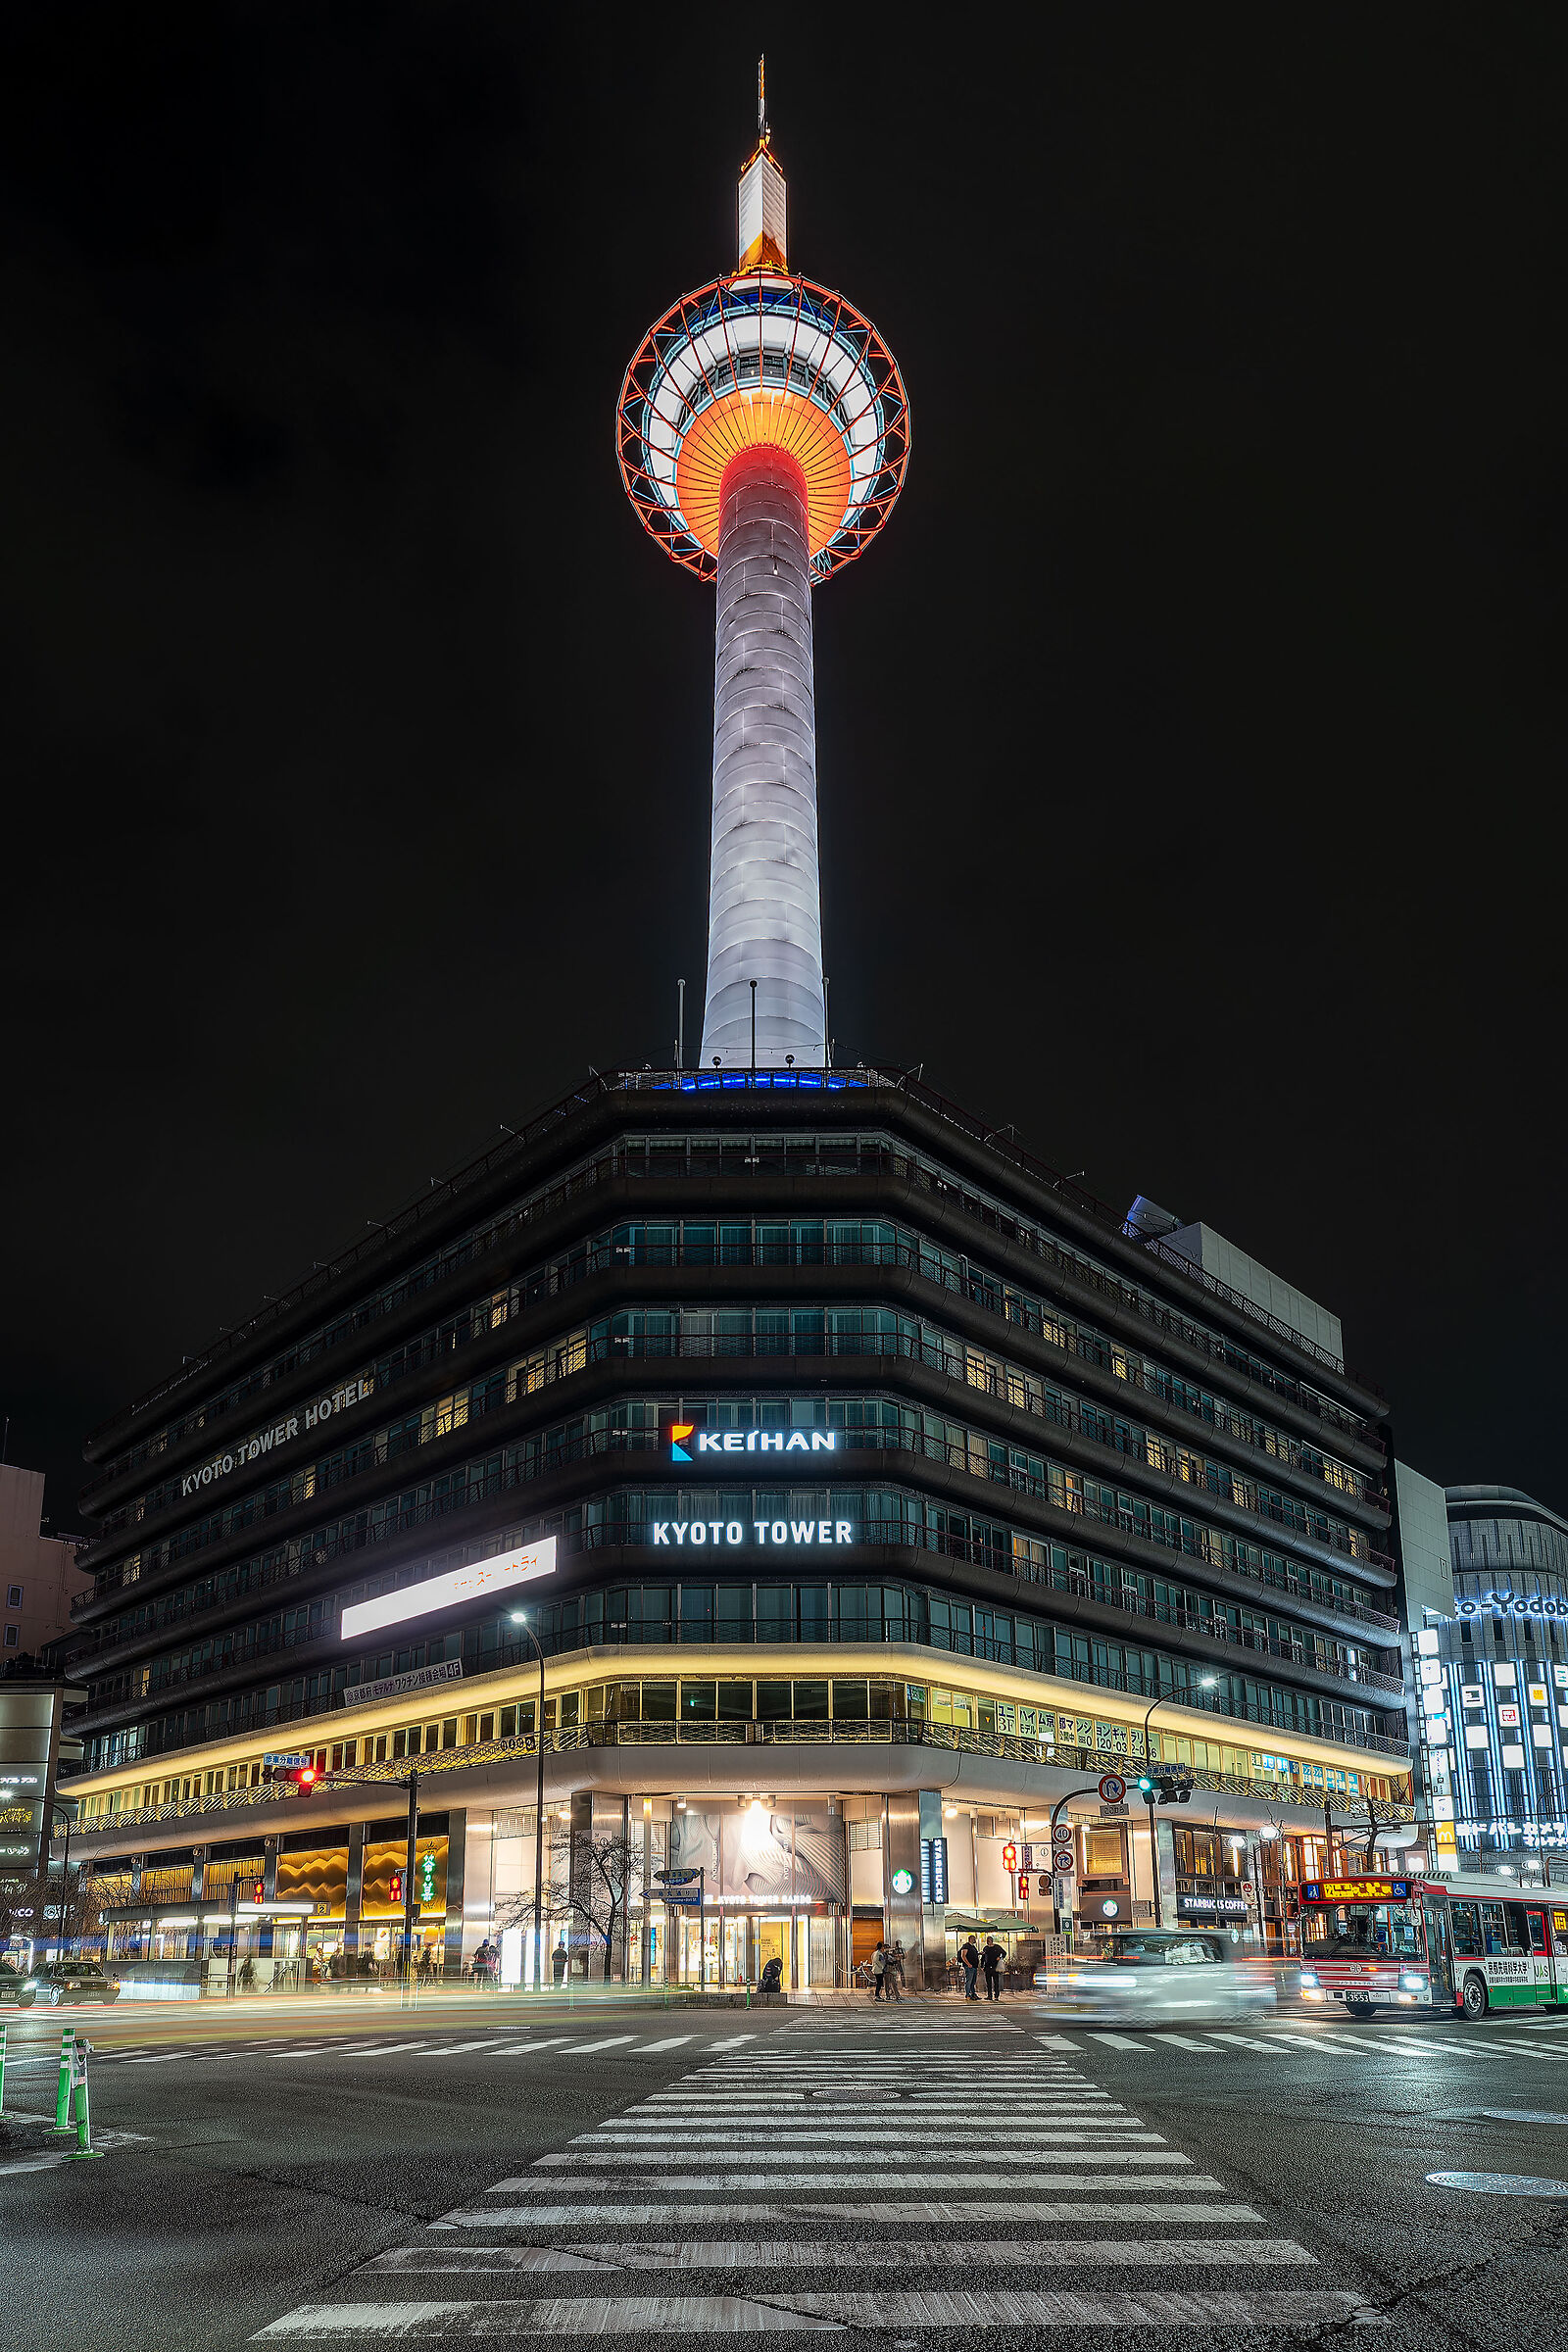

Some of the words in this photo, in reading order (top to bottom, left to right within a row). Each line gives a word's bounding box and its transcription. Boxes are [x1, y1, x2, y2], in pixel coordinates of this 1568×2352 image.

[182, 1454, 233, 1496] KYOTO
[237, 1418, 299, 1465] TOWER
[305, 1379, 369, 1430] HOTEL
[698, 1430, 835, 1451] KEIHAN
[653, 1521, 743, 1545] KYOTO
[754, 1520, 853, 1544] TOWER
[1454, 1592, 1568, 1615] o-Yodob
[448, 1662, 461, 1677] 4F
[998, 1717, 1015, 1732] 3F
[1056, 1829, 1068, 1838] 40
[1455, 1822, 1566, 1837] ヨドバシカメラ
[934, 1838, 944, 1903] STARBUCKS
[1184, 1897, 1225, 1910] STARBUCKS
[1535, 1964, 1549, 1978] UAS
